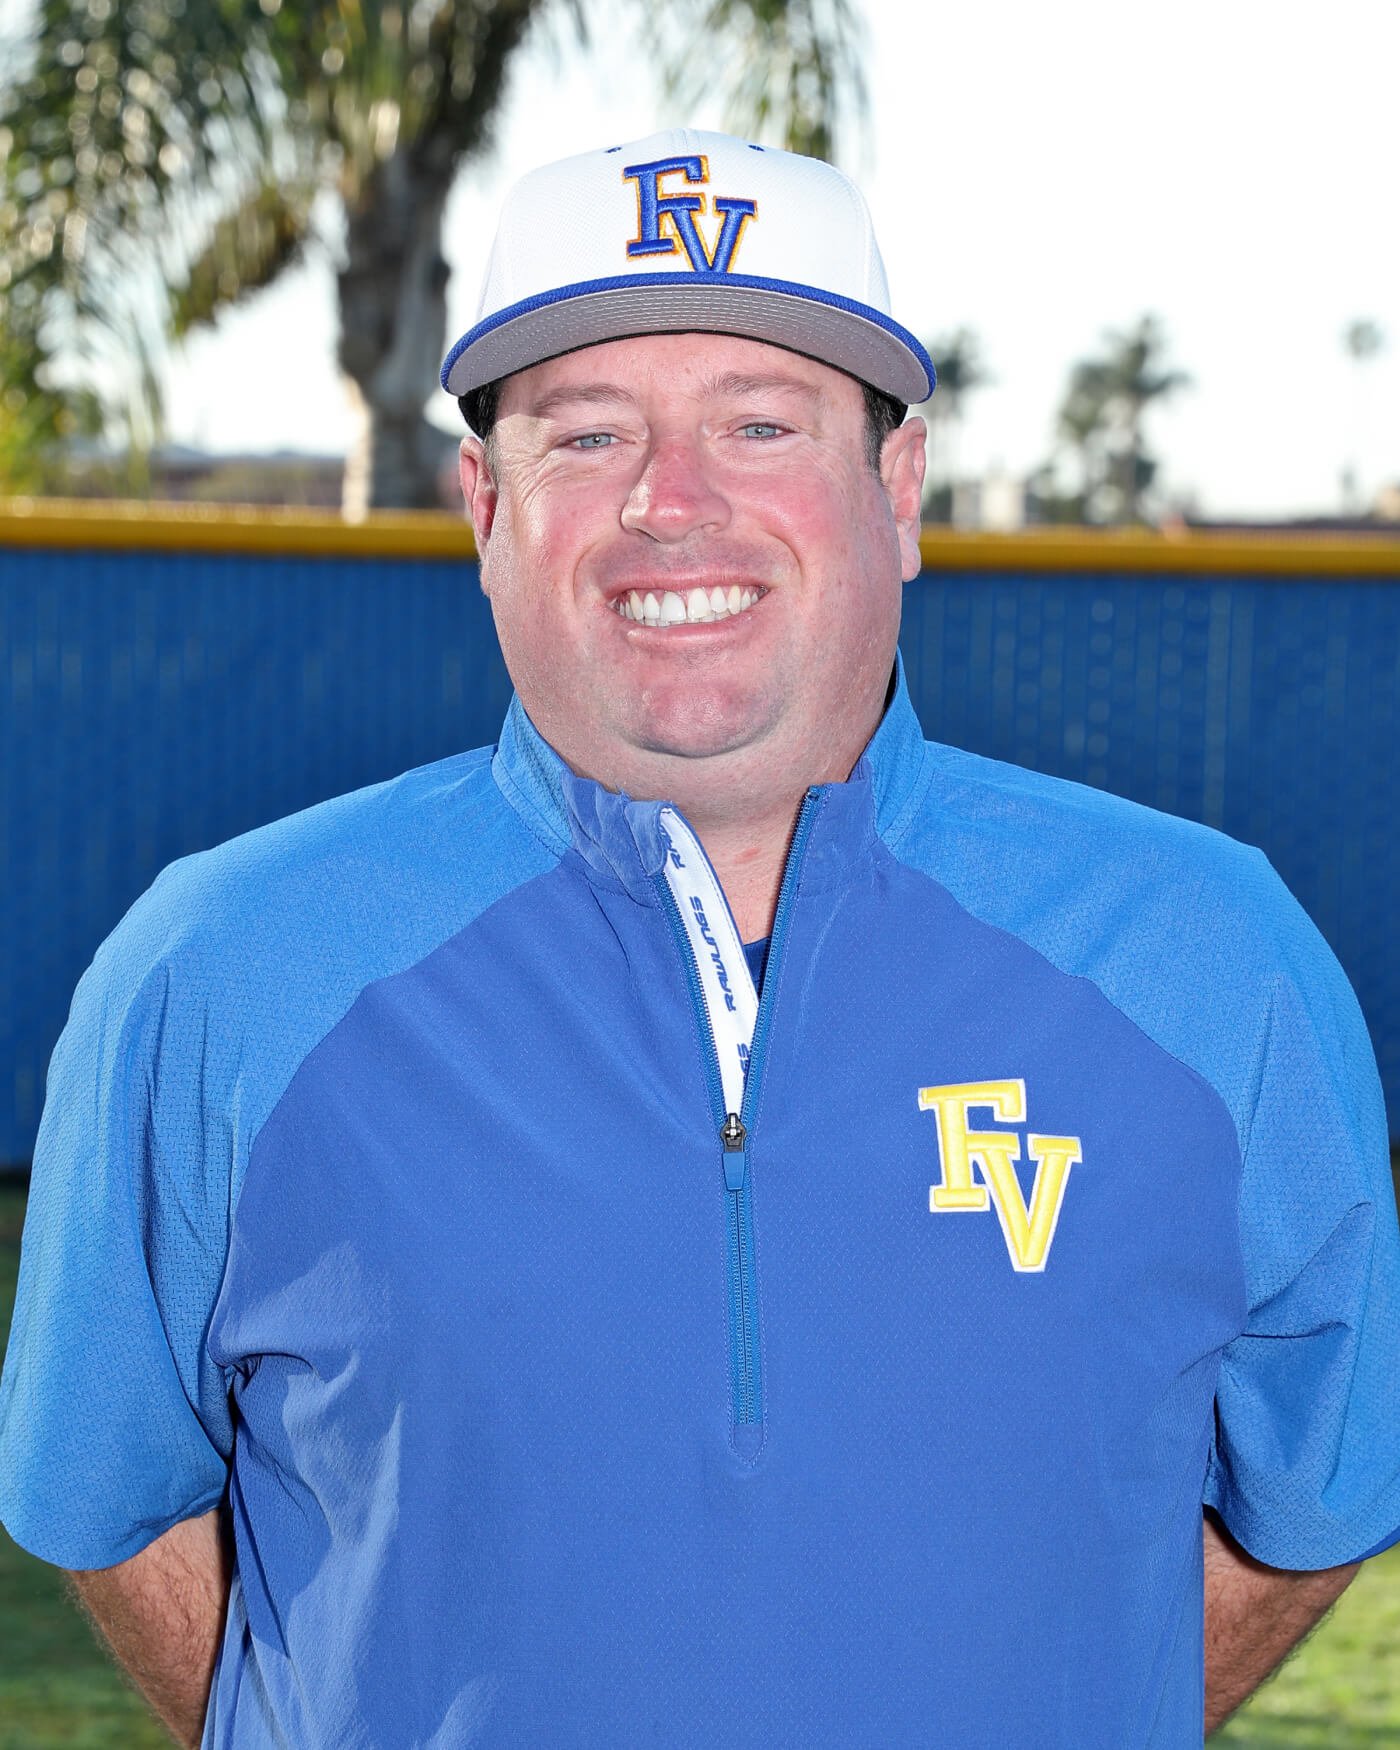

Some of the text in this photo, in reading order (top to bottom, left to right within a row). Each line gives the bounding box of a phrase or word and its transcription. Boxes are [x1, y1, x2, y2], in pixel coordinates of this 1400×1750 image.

[622, 155, 758, 272] FV
[689, 896, 737, 1012] RAWLINGS
[918, 1078, 1082, 1273] FV
